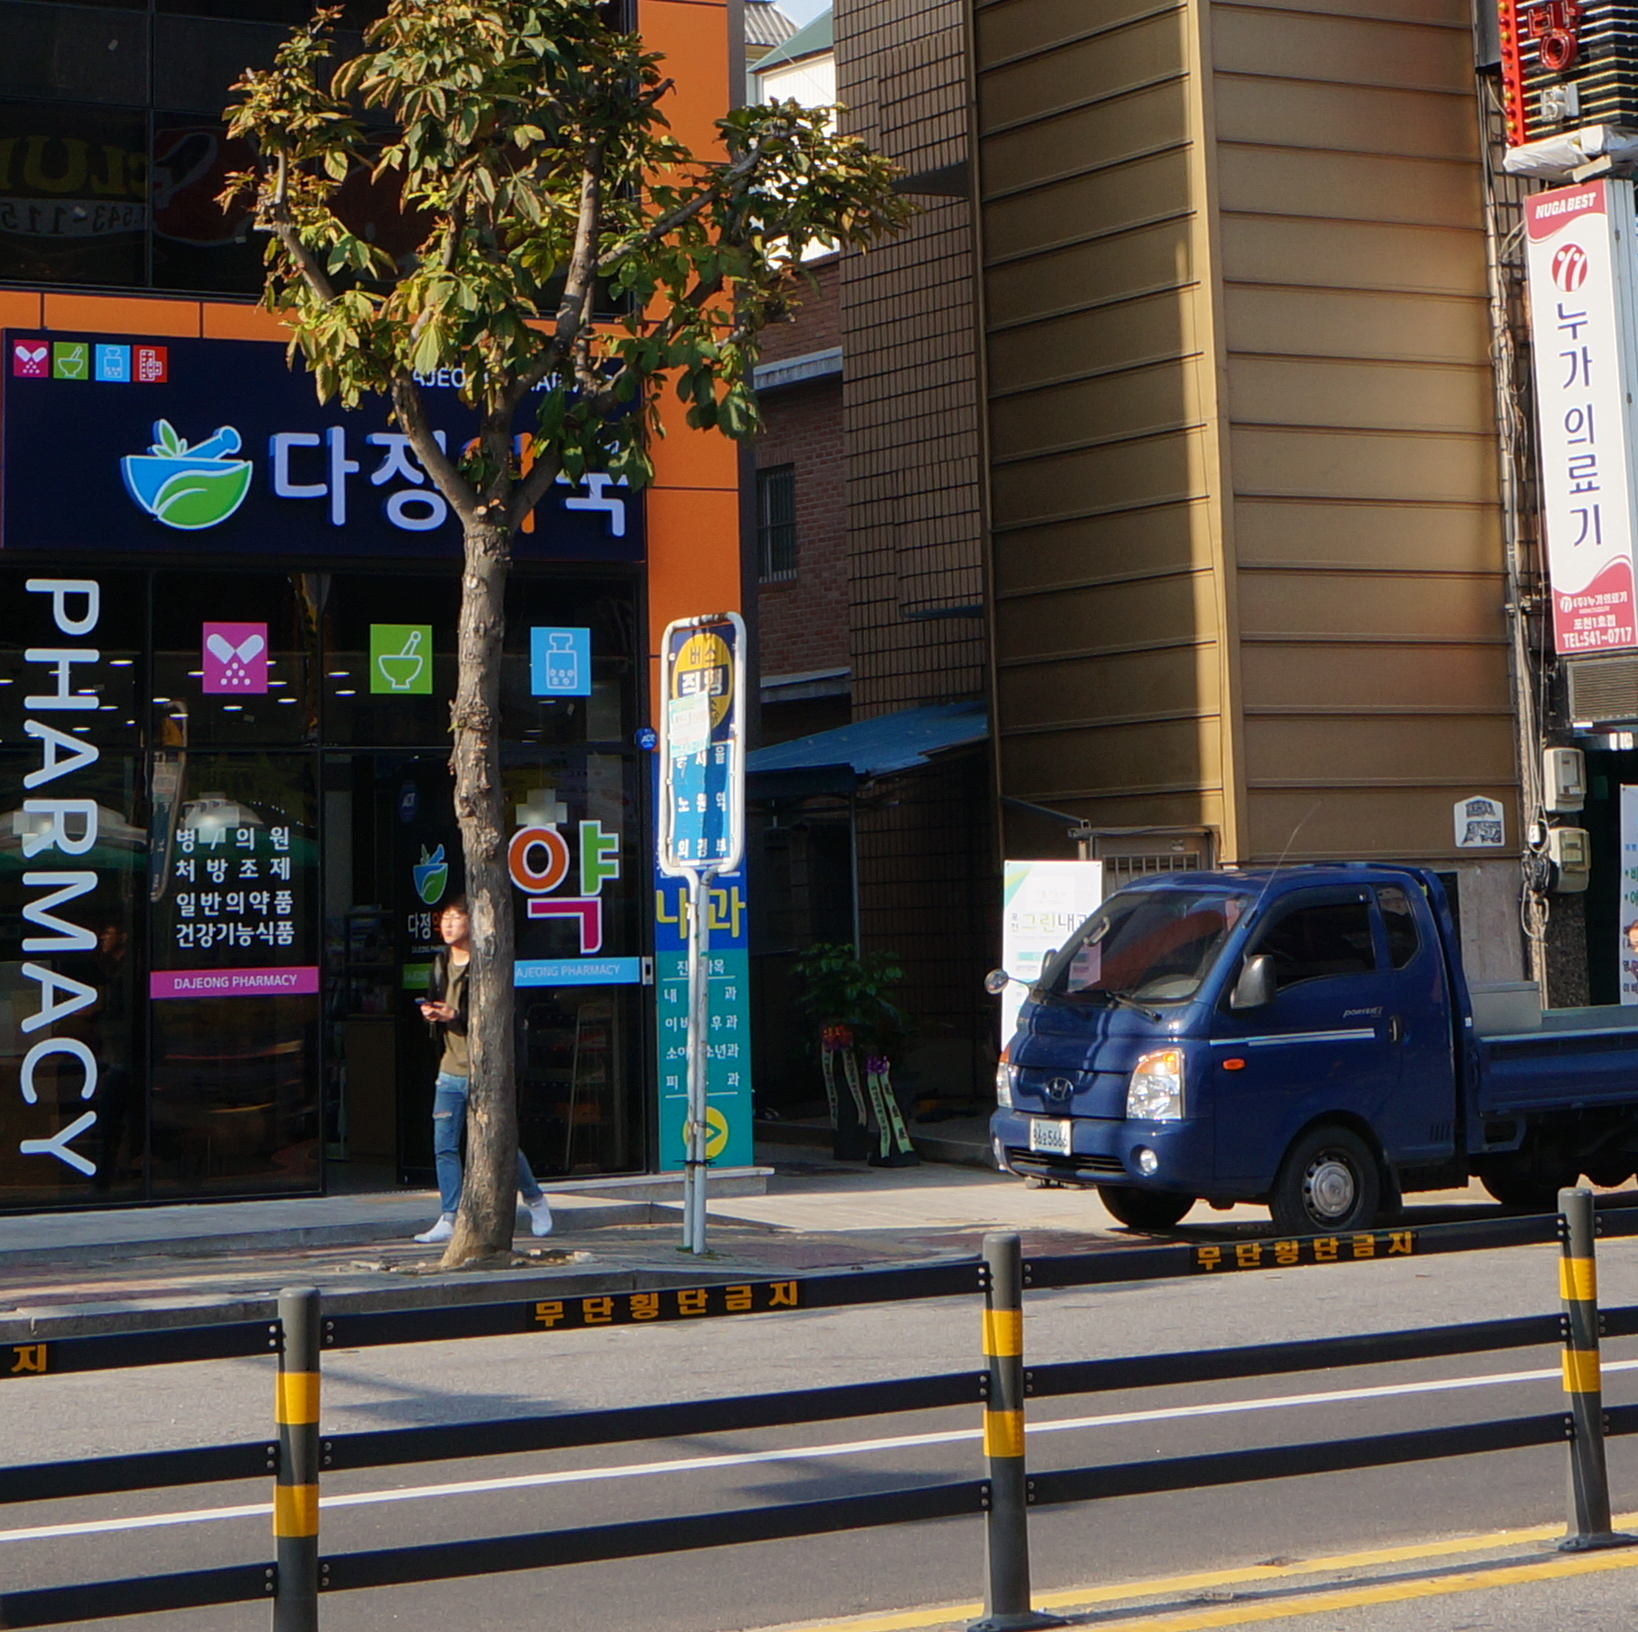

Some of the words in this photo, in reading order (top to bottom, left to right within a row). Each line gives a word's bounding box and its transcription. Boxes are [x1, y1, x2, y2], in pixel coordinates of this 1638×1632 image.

[1556, 302, 1603, 547] 누가의료기
[19, 578, 100, 1176] PHARMACY
[507, 819, 621, 954] 약
[176, 890, 293, 918] 일반의약품
[176, 921, 295, 948] 건강기능식품
[173, 976, 230, 991] DAJEONG
[232, 974, 298, 989] PHARMACY
[514, 966, 559, 979] AJEONG
[561, 964, 621, 978] PHARMACY
[1197, 1231, 1416, 1271] 무단횡단금지
[534, 1279, 800, 1328] 무단횡단금지
